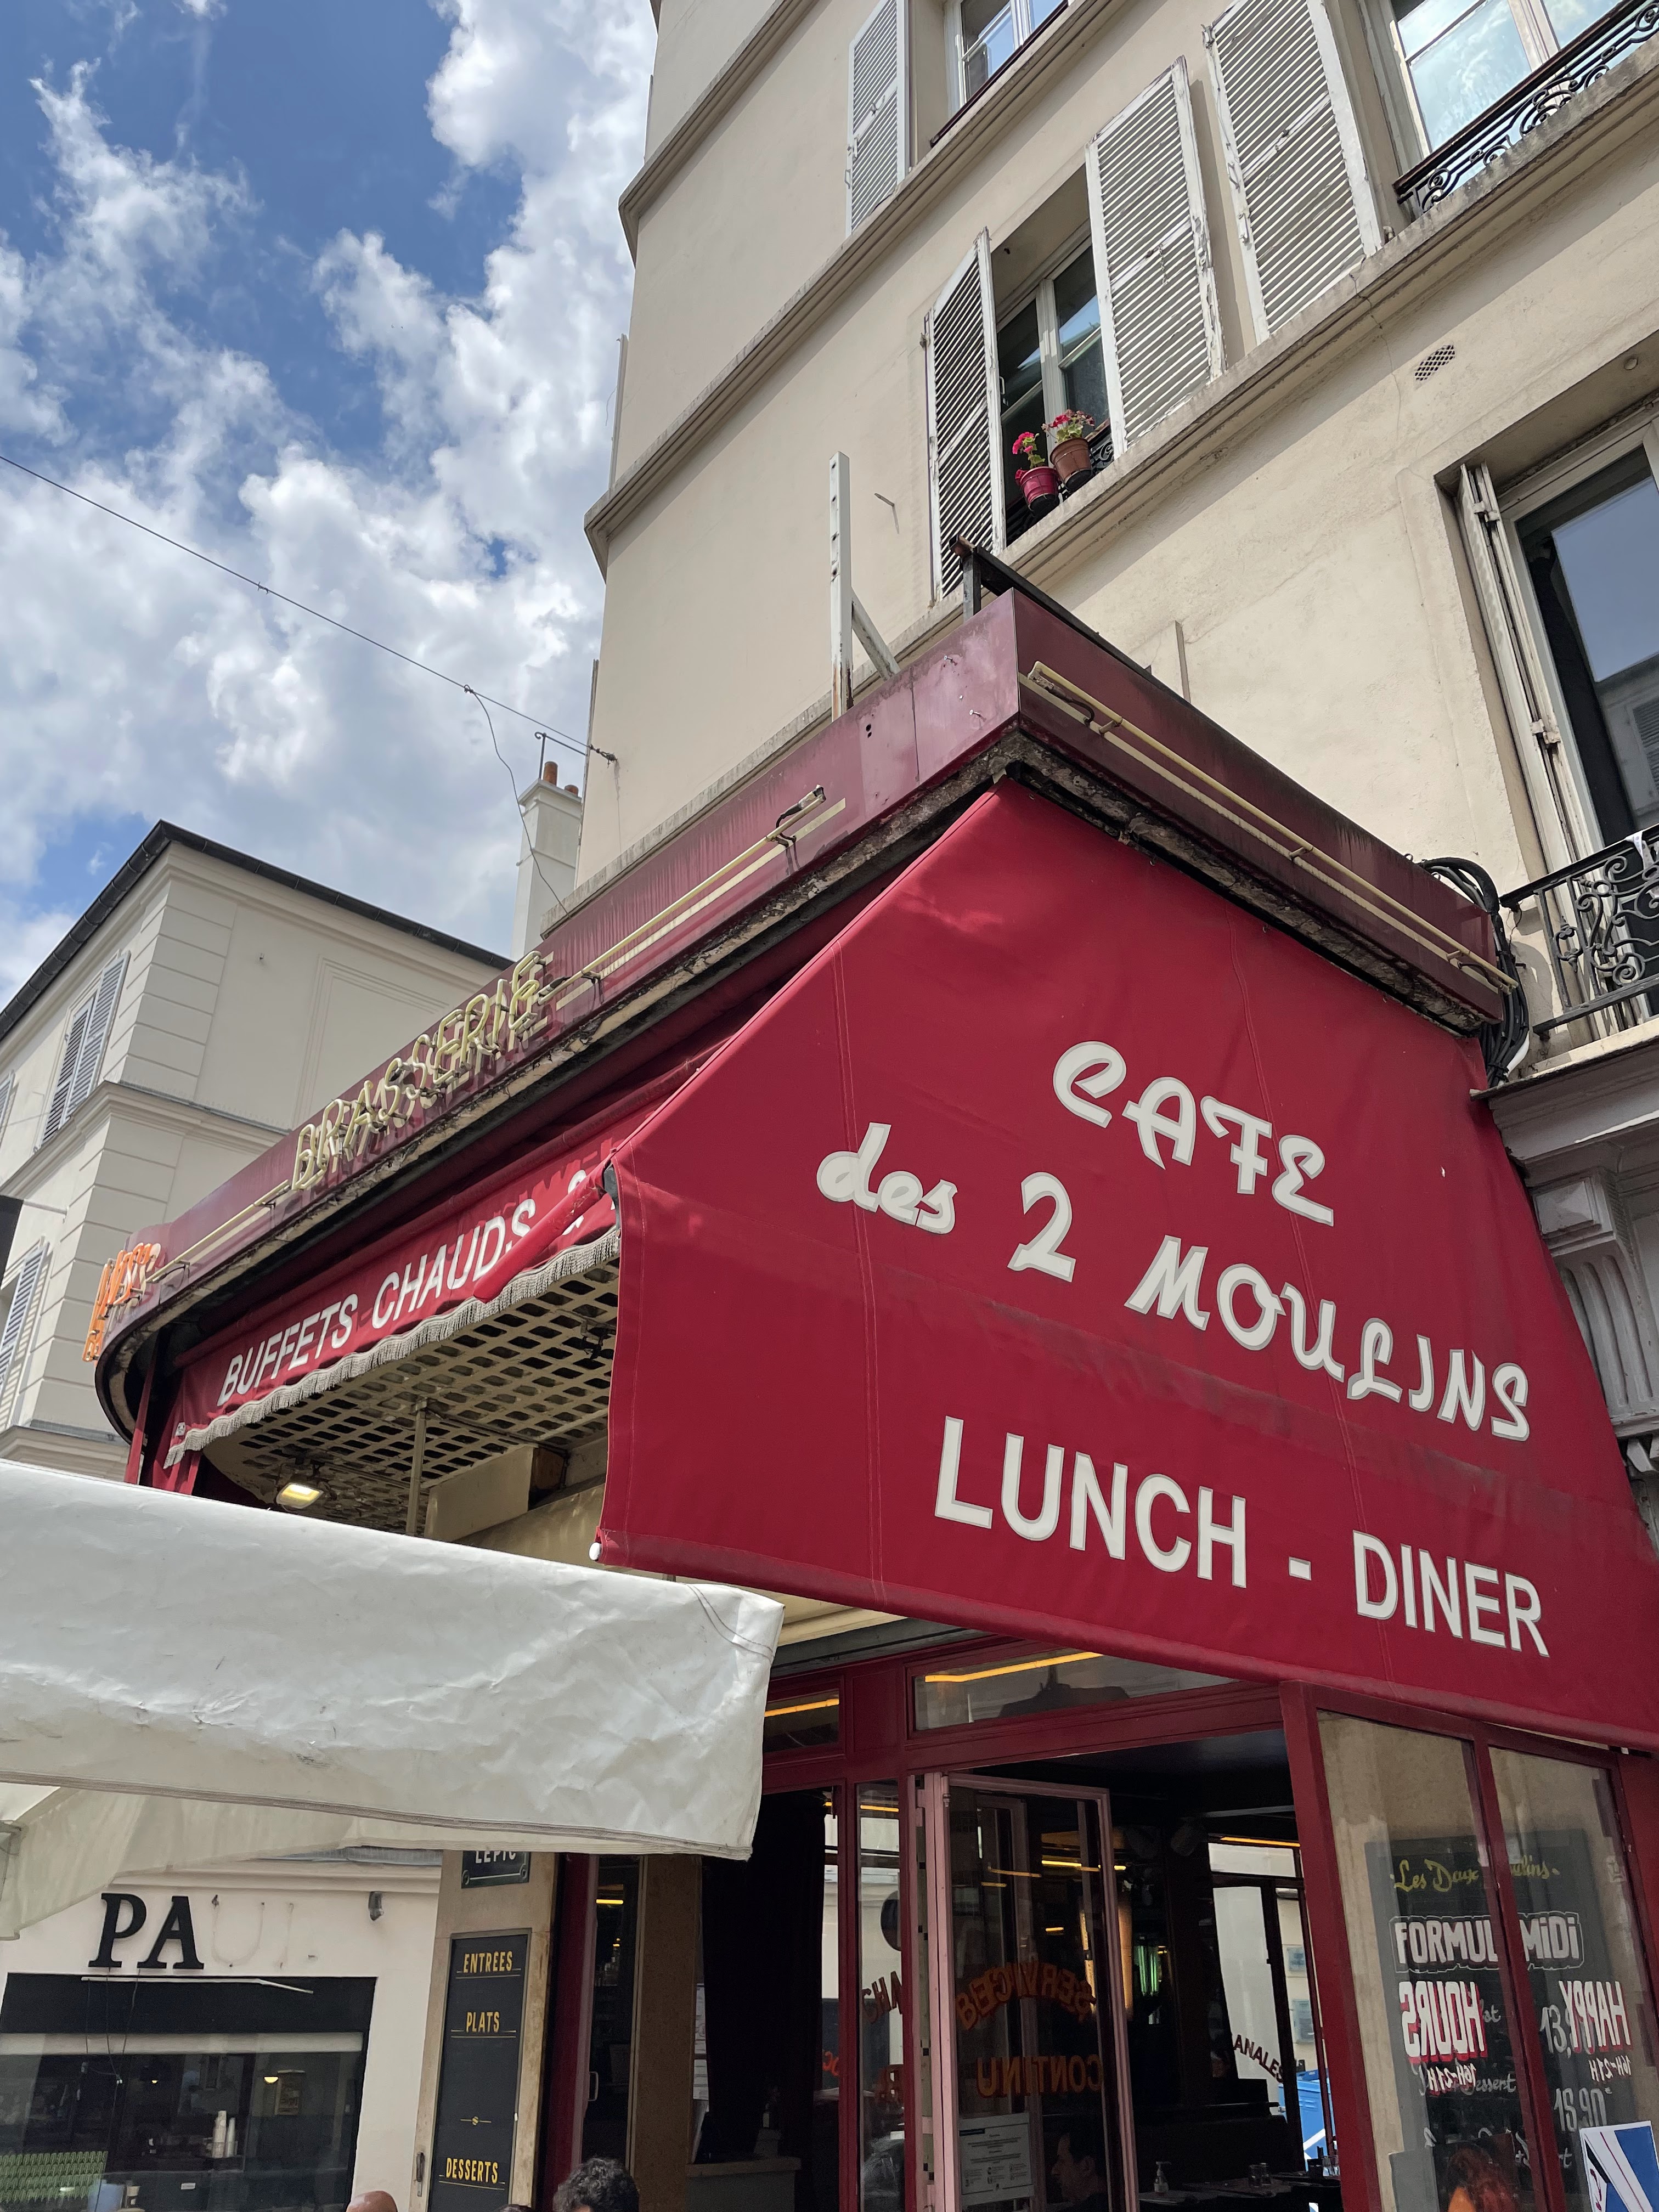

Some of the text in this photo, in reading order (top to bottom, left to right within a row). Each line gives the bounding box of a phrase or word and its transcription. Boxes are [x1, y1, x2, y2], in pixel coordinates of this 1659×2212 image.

[291, 951, 550, 1190] BRASSERIE
[217, 1293, 358, 1407] BUFFETS
[371, 1198, 536, 1329] CHAUDS
[816, 1122, 1530, 1441] des 2 MOULINS
[935, 1416, 1247, 1588] LUNCH
[1352, 1530, 1550, 1657] DINER
[1393, 1859, 1427, 1892] Les
[1394, 1919, 1500, 1965] FORMUL
[466, 2011, 500, 2033] PLATS
[445, 2157, 498, 2184] DESSERTS
